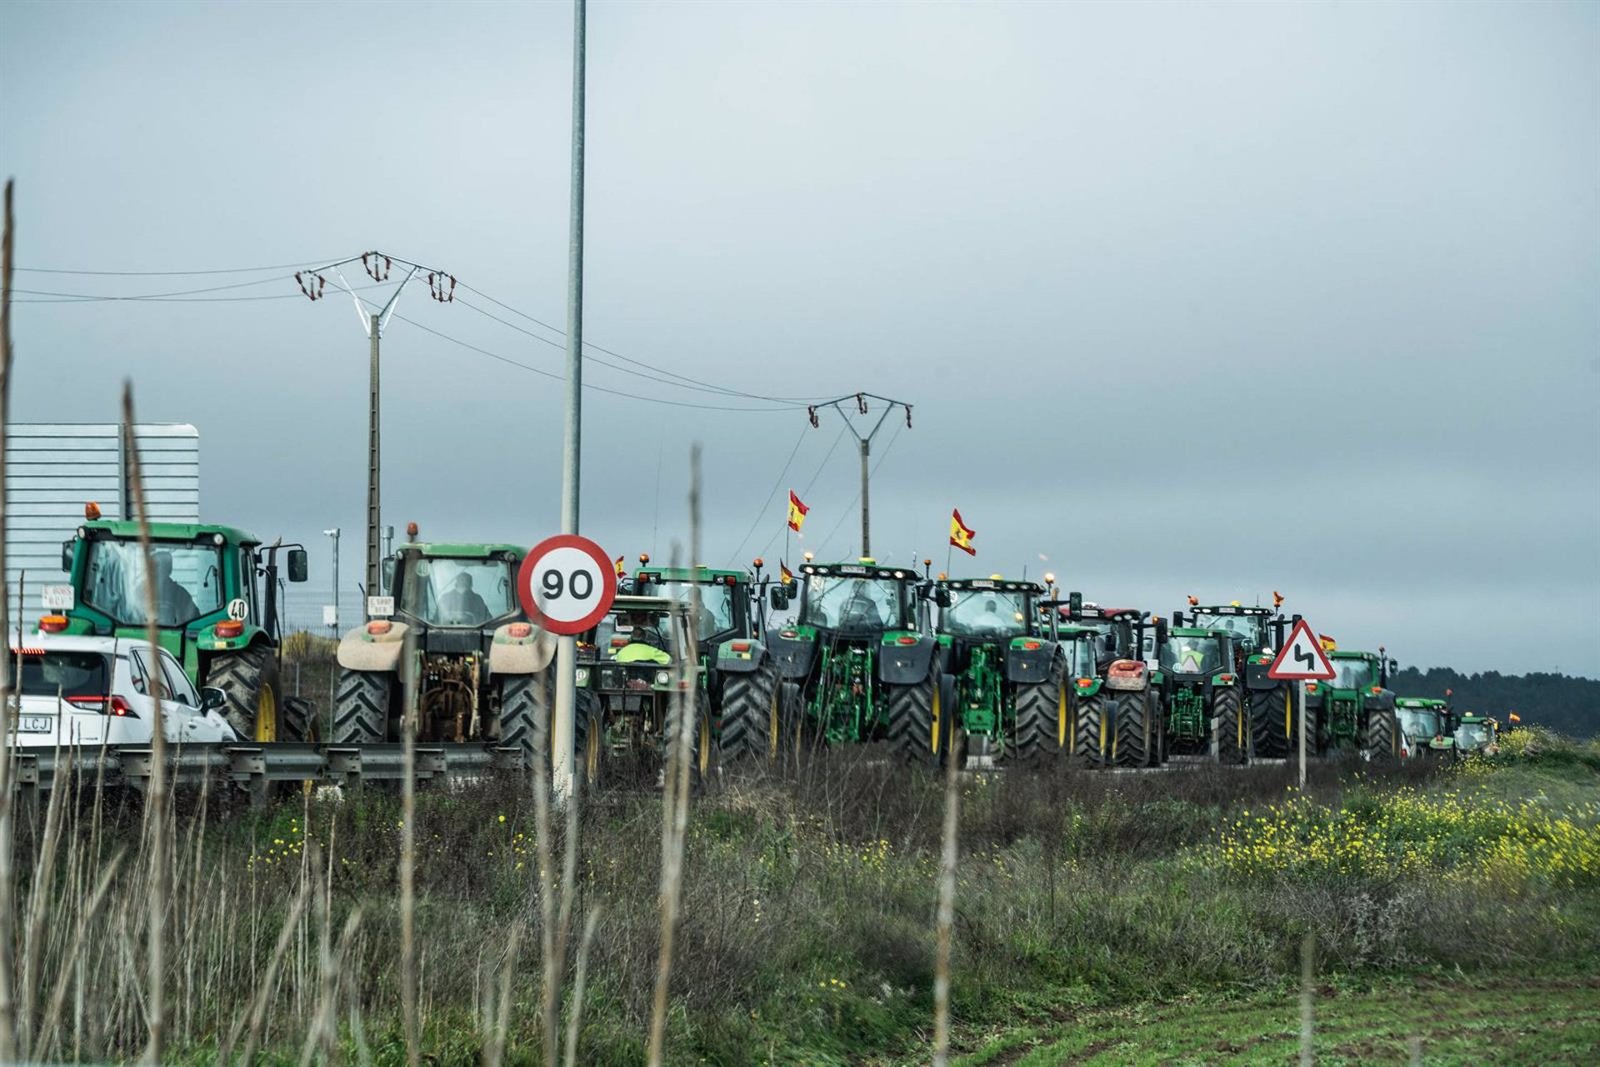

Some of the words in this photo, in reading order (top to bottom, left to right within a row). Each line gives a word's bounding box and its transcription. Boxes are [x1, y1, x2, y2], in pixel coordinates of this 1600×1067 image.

[542, 569, 593, 600] 90
[231, 601, 245, 618] 40
[24, 718, 48, 730] LCJ
